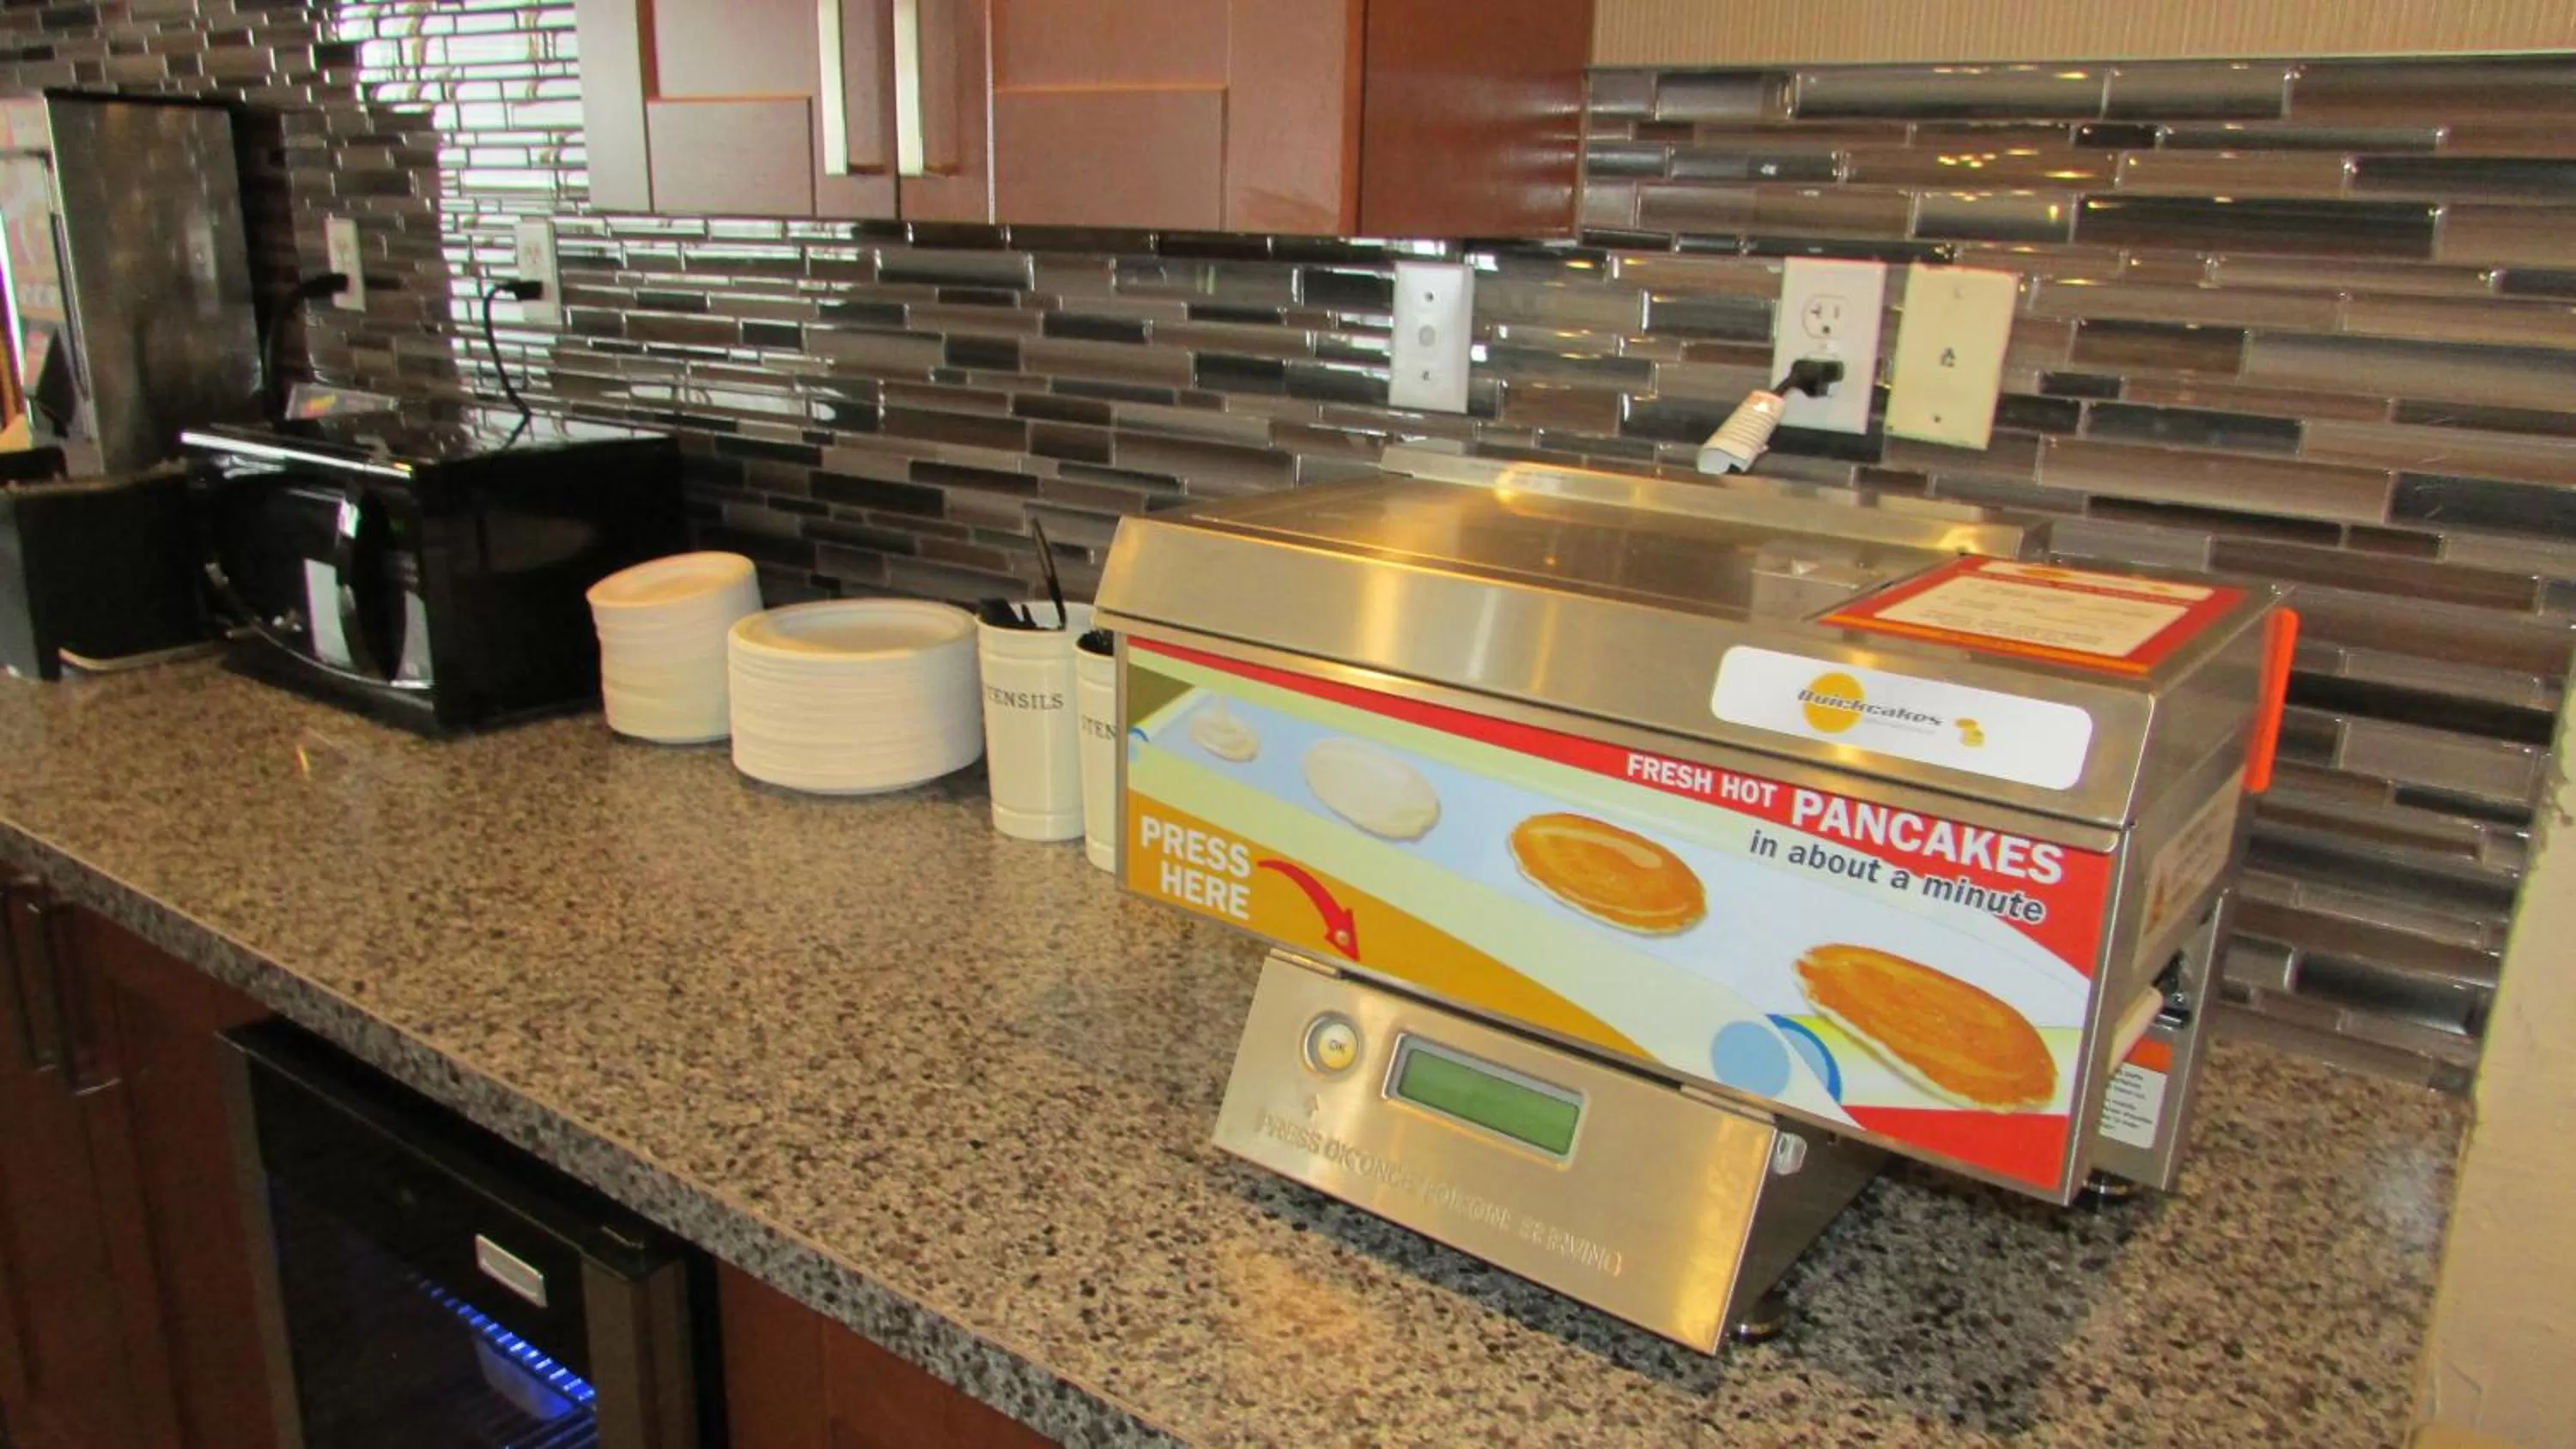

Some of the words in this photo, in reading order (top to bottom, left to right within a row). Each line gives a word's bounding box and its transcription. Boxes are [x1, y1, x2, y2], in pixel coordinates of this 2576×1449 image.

[1139, 815, 1252, 879] PRESS
[1626, 753, 1712, 794] FRESH
[1721, 773, 1777, 809] HOT
[1791, 789, 2063, 885] PANCAKES
[1160, 861, 1251, 921] HERE
[1750, 830, 1778, 858] in
[1788, 841, 1881, 884] about
[1890, 870, 1911, 891] a
[1922, 876, 2046, 925] minute
[1255, 1106, 1322, 1155] PRESS
